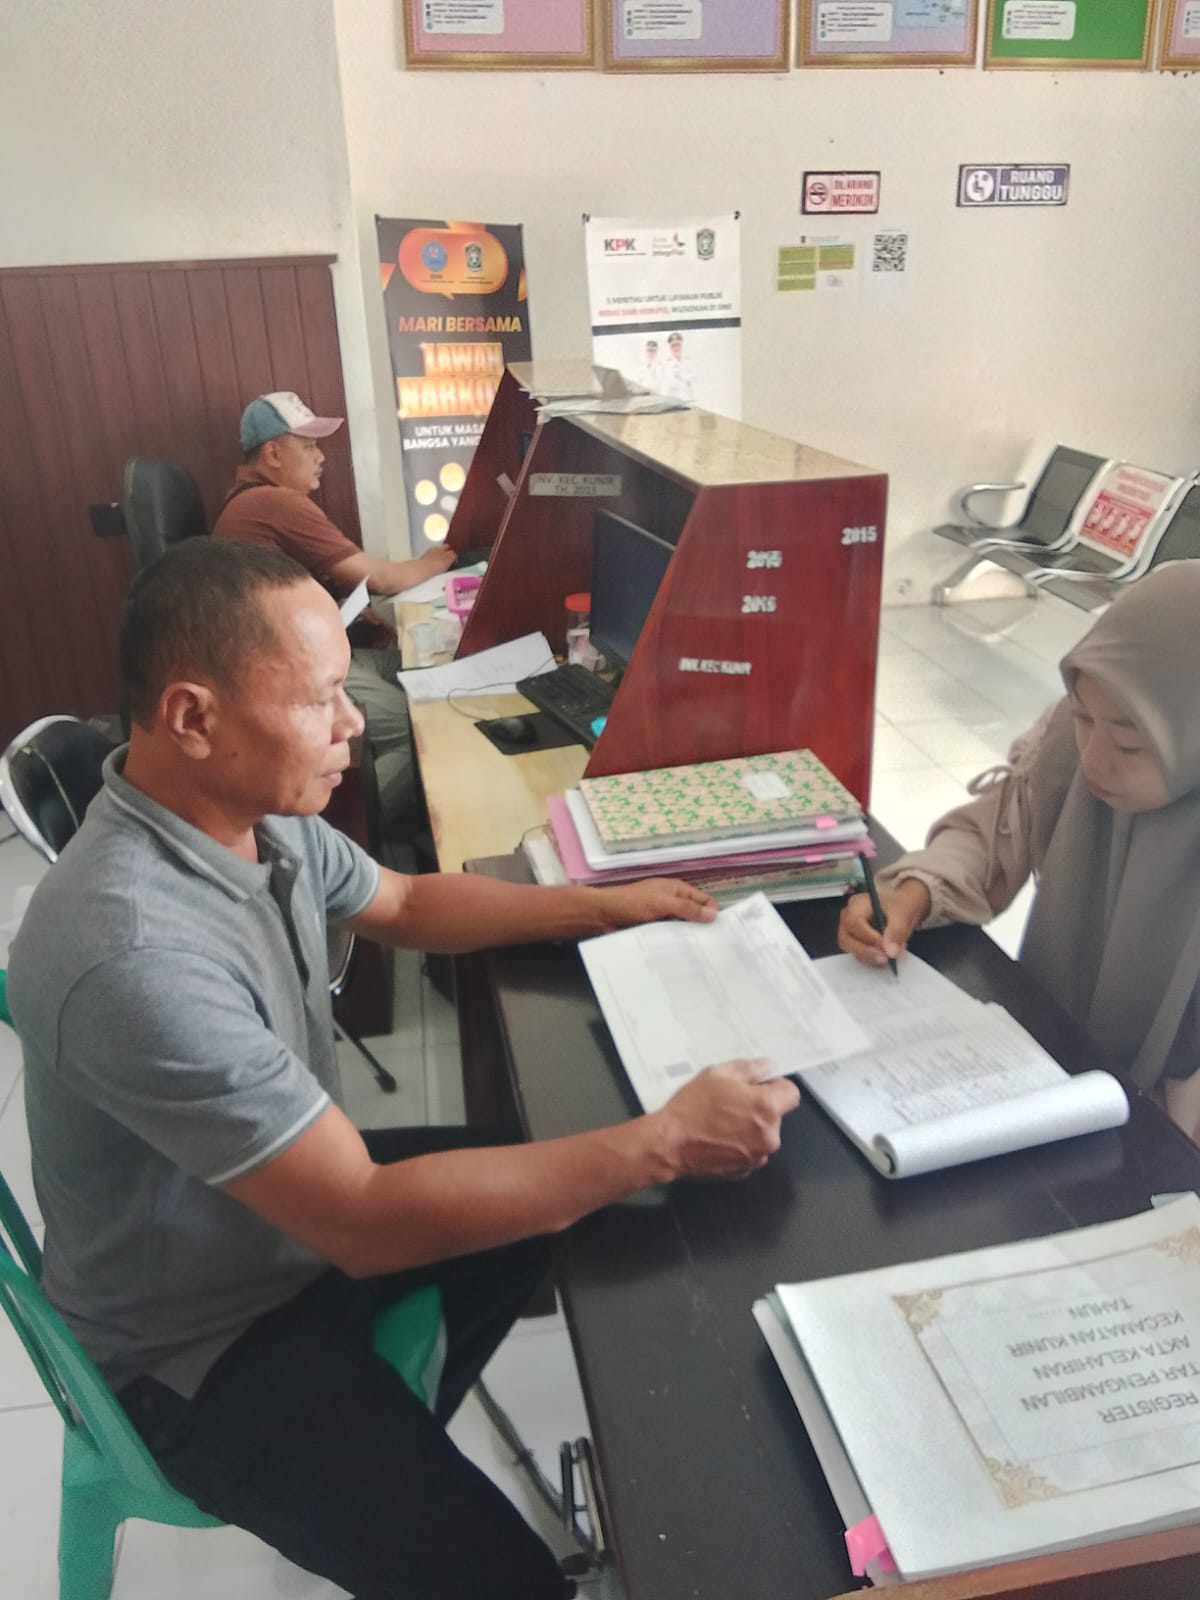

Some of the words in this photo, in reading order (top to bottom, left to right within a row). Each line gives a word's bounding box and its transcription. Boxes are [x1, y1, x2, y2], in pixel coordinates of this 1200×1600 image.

[1010, 170, 1055, 184] RUANG
[999, 185, 1063, 201] TUNGGU
[604, 238, 637, 252] KPK
[399, 316, 443, 332] MARI
[445, 316, 523, 332] BERSAMA
[414, 424, 454, 437] UNTUK
[402, 436, 450, 451] BANGSA
[841, 525, 878, 545] 2015
[1068, 1296, 1134, 1320] TAHUN
[1069, 1310, 1185, 1346] KECAMATAN
[1006, 1335, 1069, 1358] KUNIR
[1142, 1335, 1191, 1358] AKTA
[1032, 1346, 1142, 1381] KELAHIRAN
[1020, 1370, 1161, 1412] PENGAMBILAN
[1097, 1390, 1200, 1424] REGISTER
